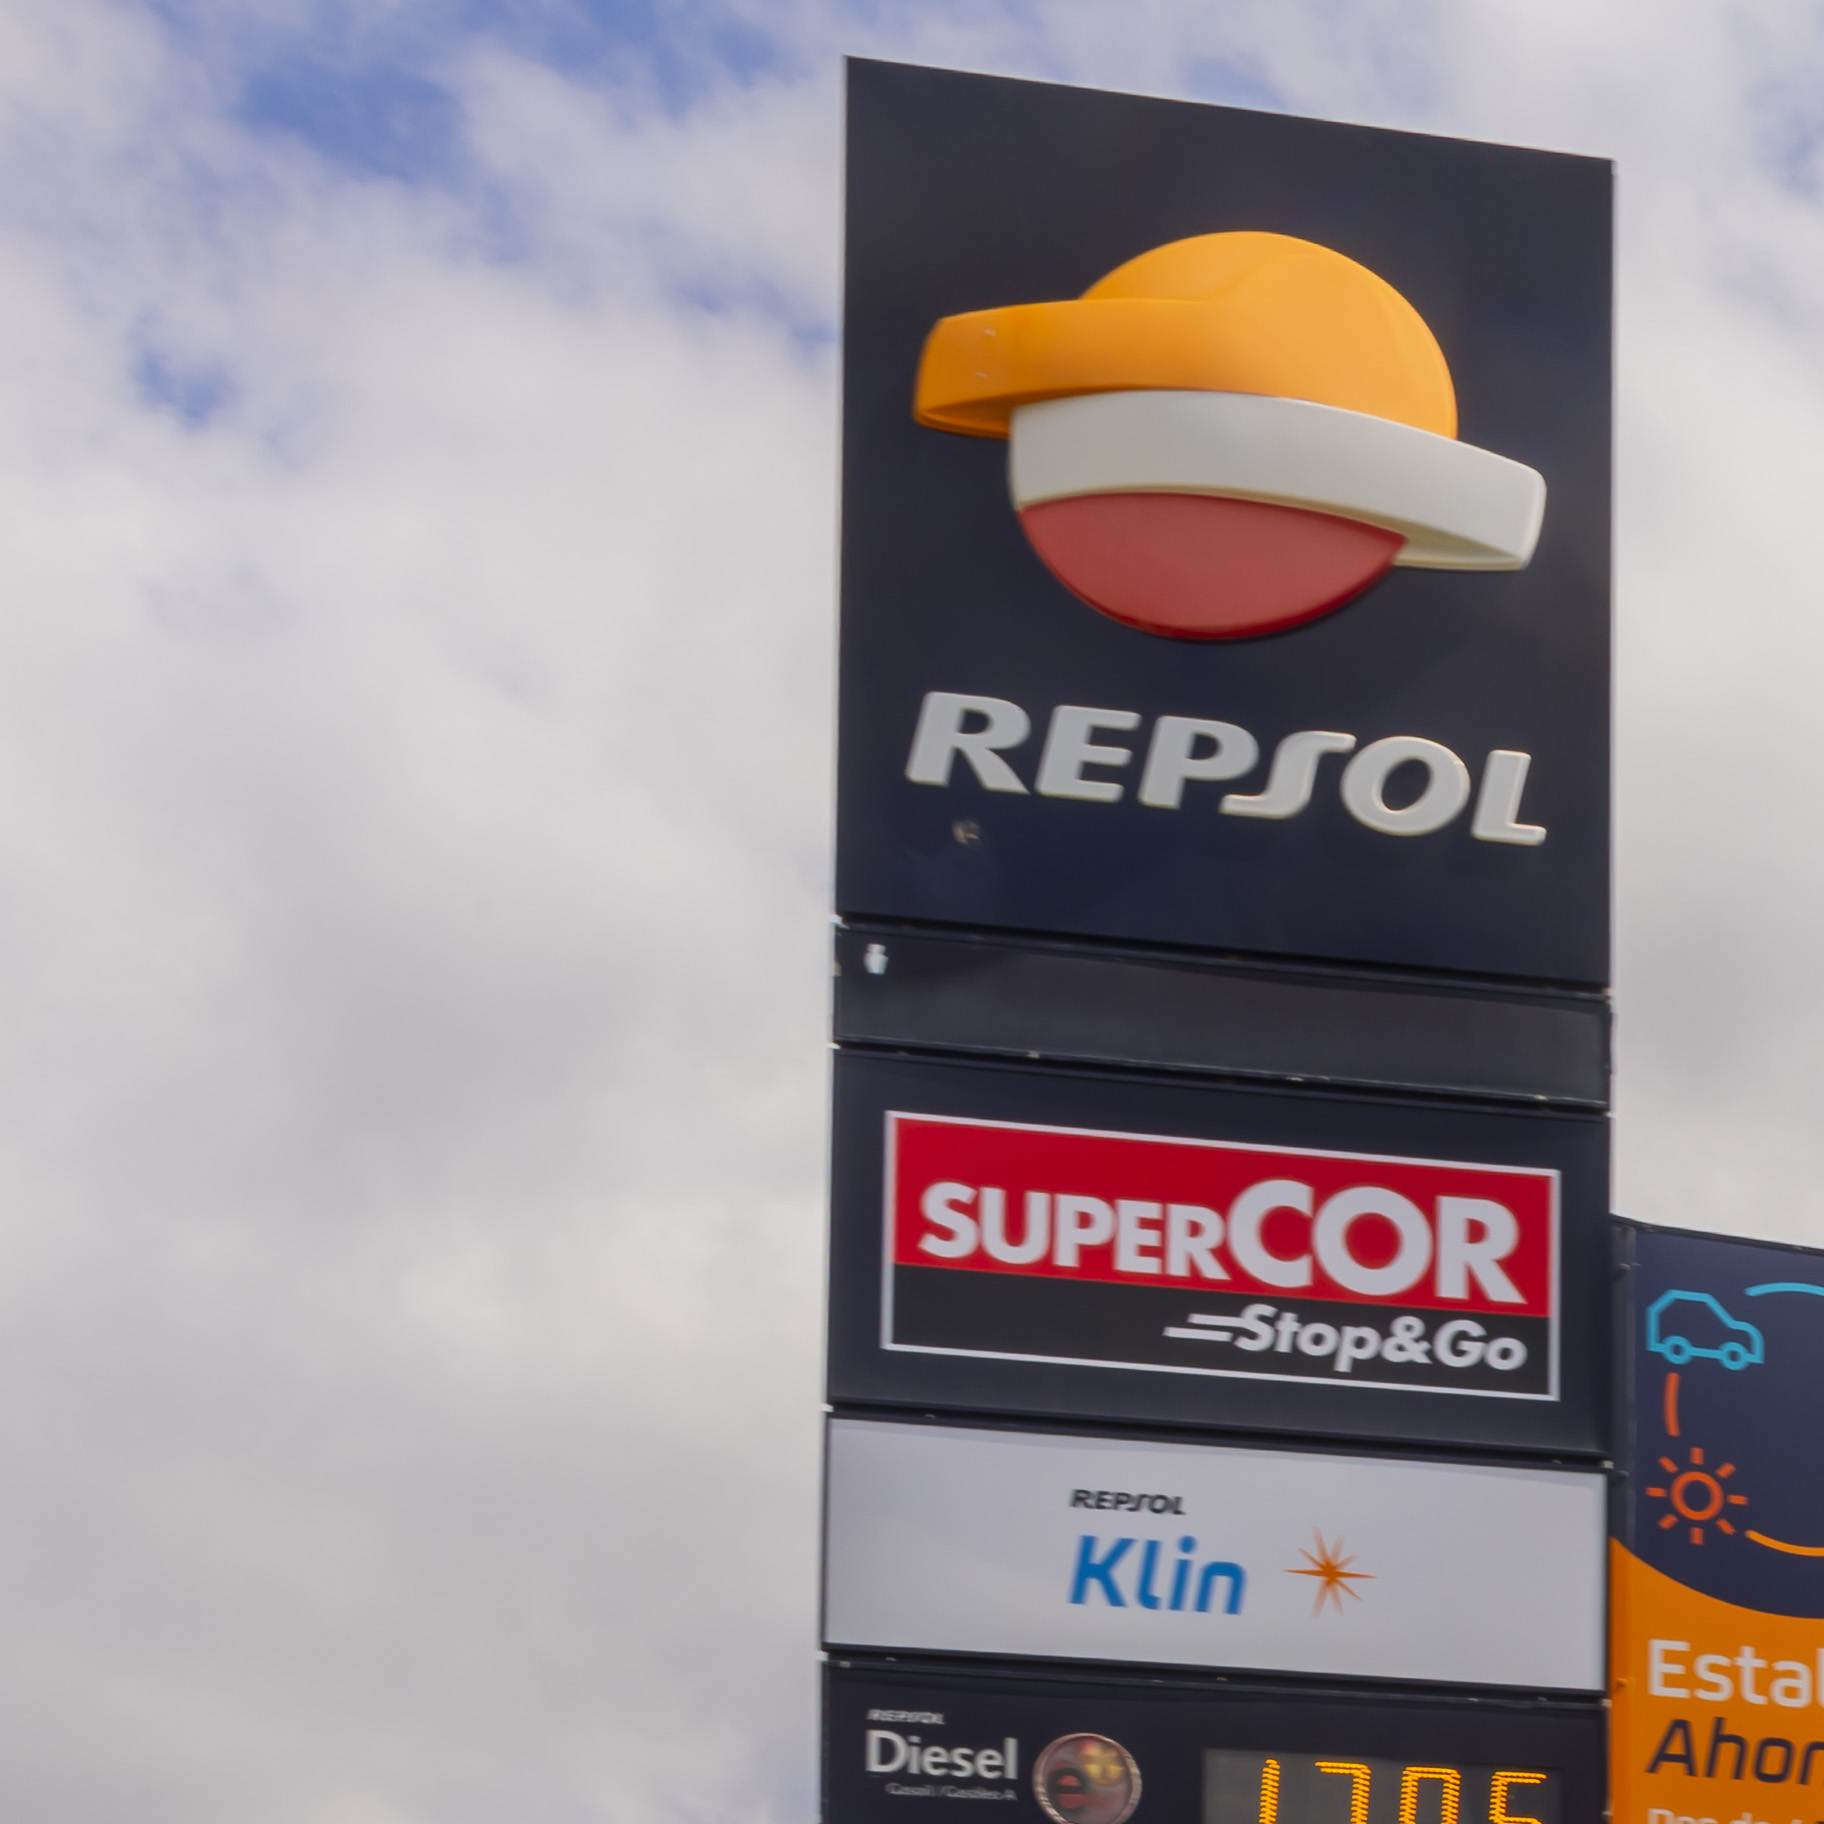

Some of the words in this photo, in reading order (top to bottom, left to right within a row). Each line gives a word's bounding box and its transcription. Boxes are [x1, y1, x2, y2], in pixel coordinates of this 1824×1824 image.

[905, 690, 1548, 846] REPSOL
[918, 1178, 1527, 1305] SUPERCOR
[1240, 1304, 1528, 1372] Stop&Go
[1069, 1488, 1186, 1517] REPSOL
[1067, 1534, 1246, 1616] Klin
[865, 1729, 1018, 1780] Diesel
